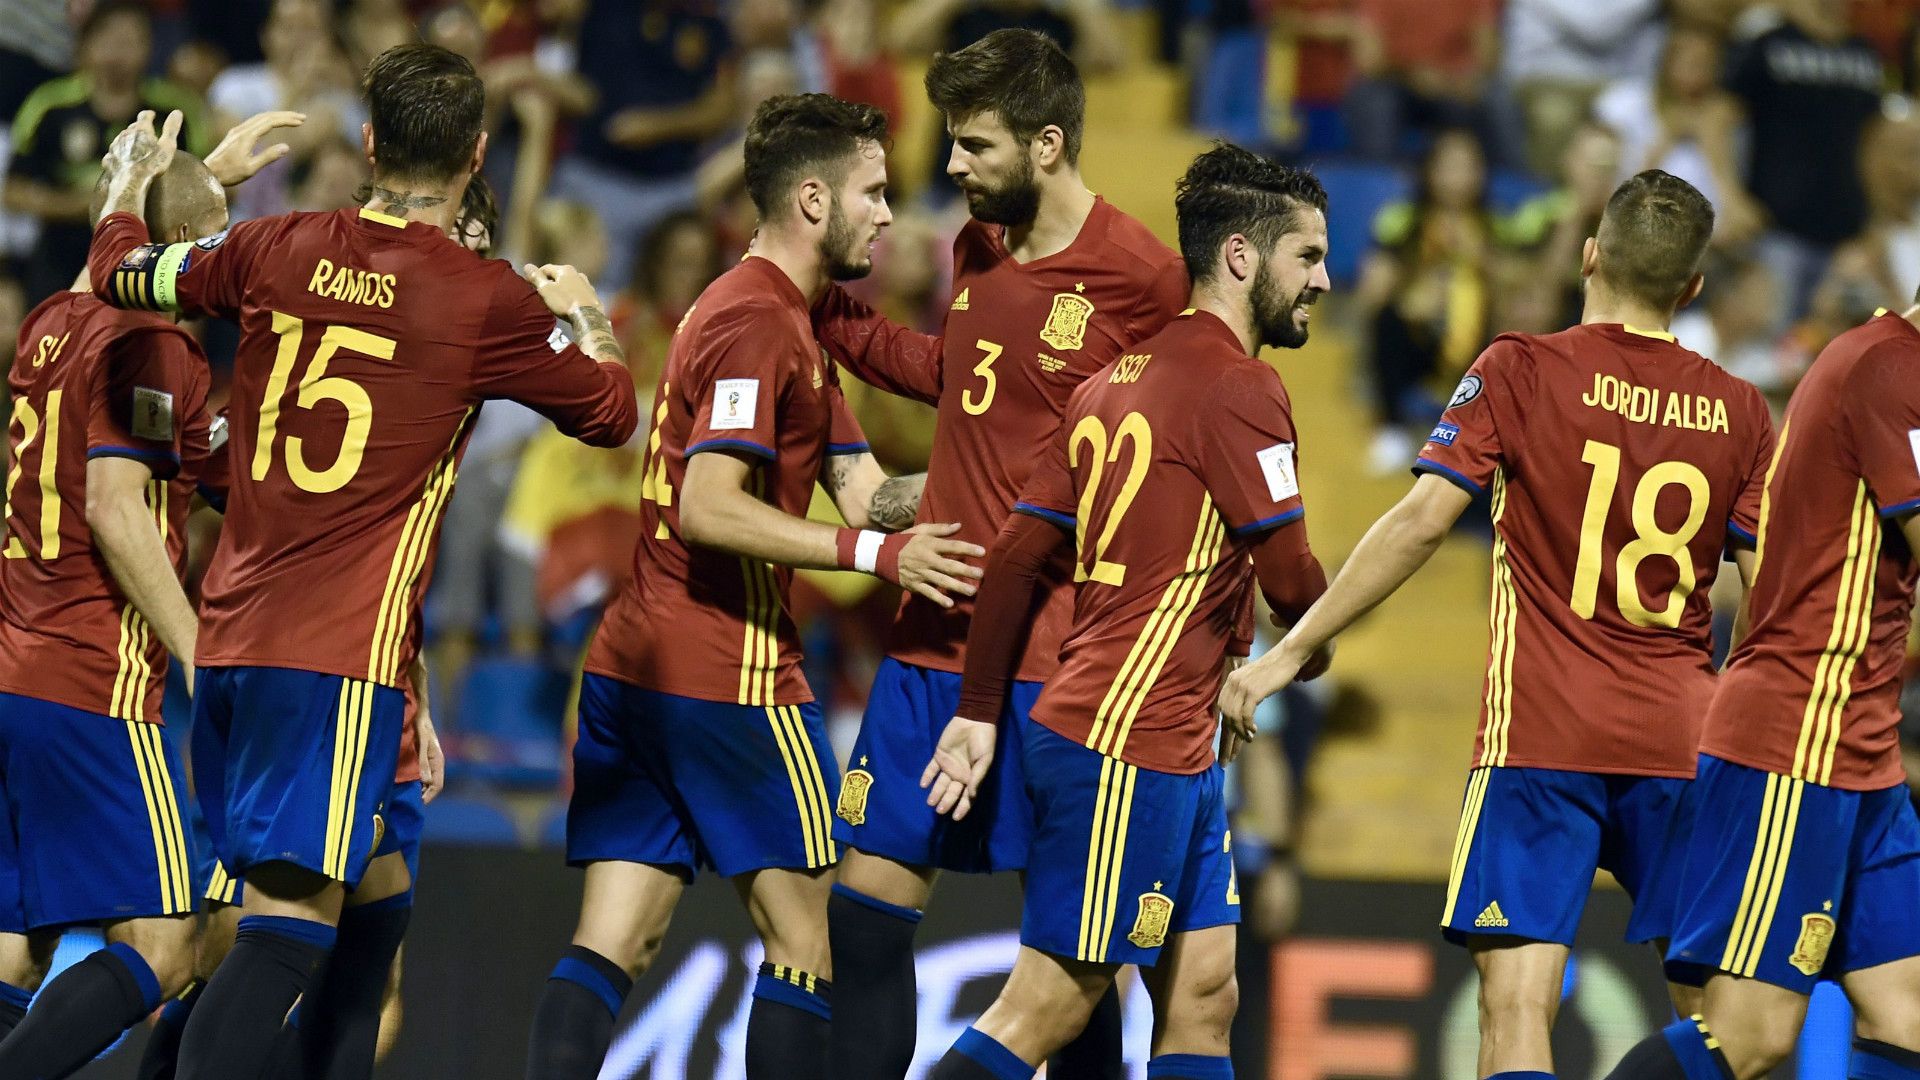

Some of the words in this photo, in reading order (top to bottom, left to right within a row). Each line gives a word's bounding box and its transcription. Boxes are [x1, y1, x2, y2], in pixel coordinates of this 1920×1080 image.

[308, 258, 396, 309] RAMOS
[251, 310, 397, 494] 15
[961, 338, 1004, 416] 3
[1108, 354, 1152, 384] ISCO
[1582, 372, 1659, 425] JORDI
[1662, 391, 1730, 435] ALBA
[1068, 411, 1153, 587] 22
[1570, 438, 1711, 629] 18
[1474, 918, 1509, 928] adidas
